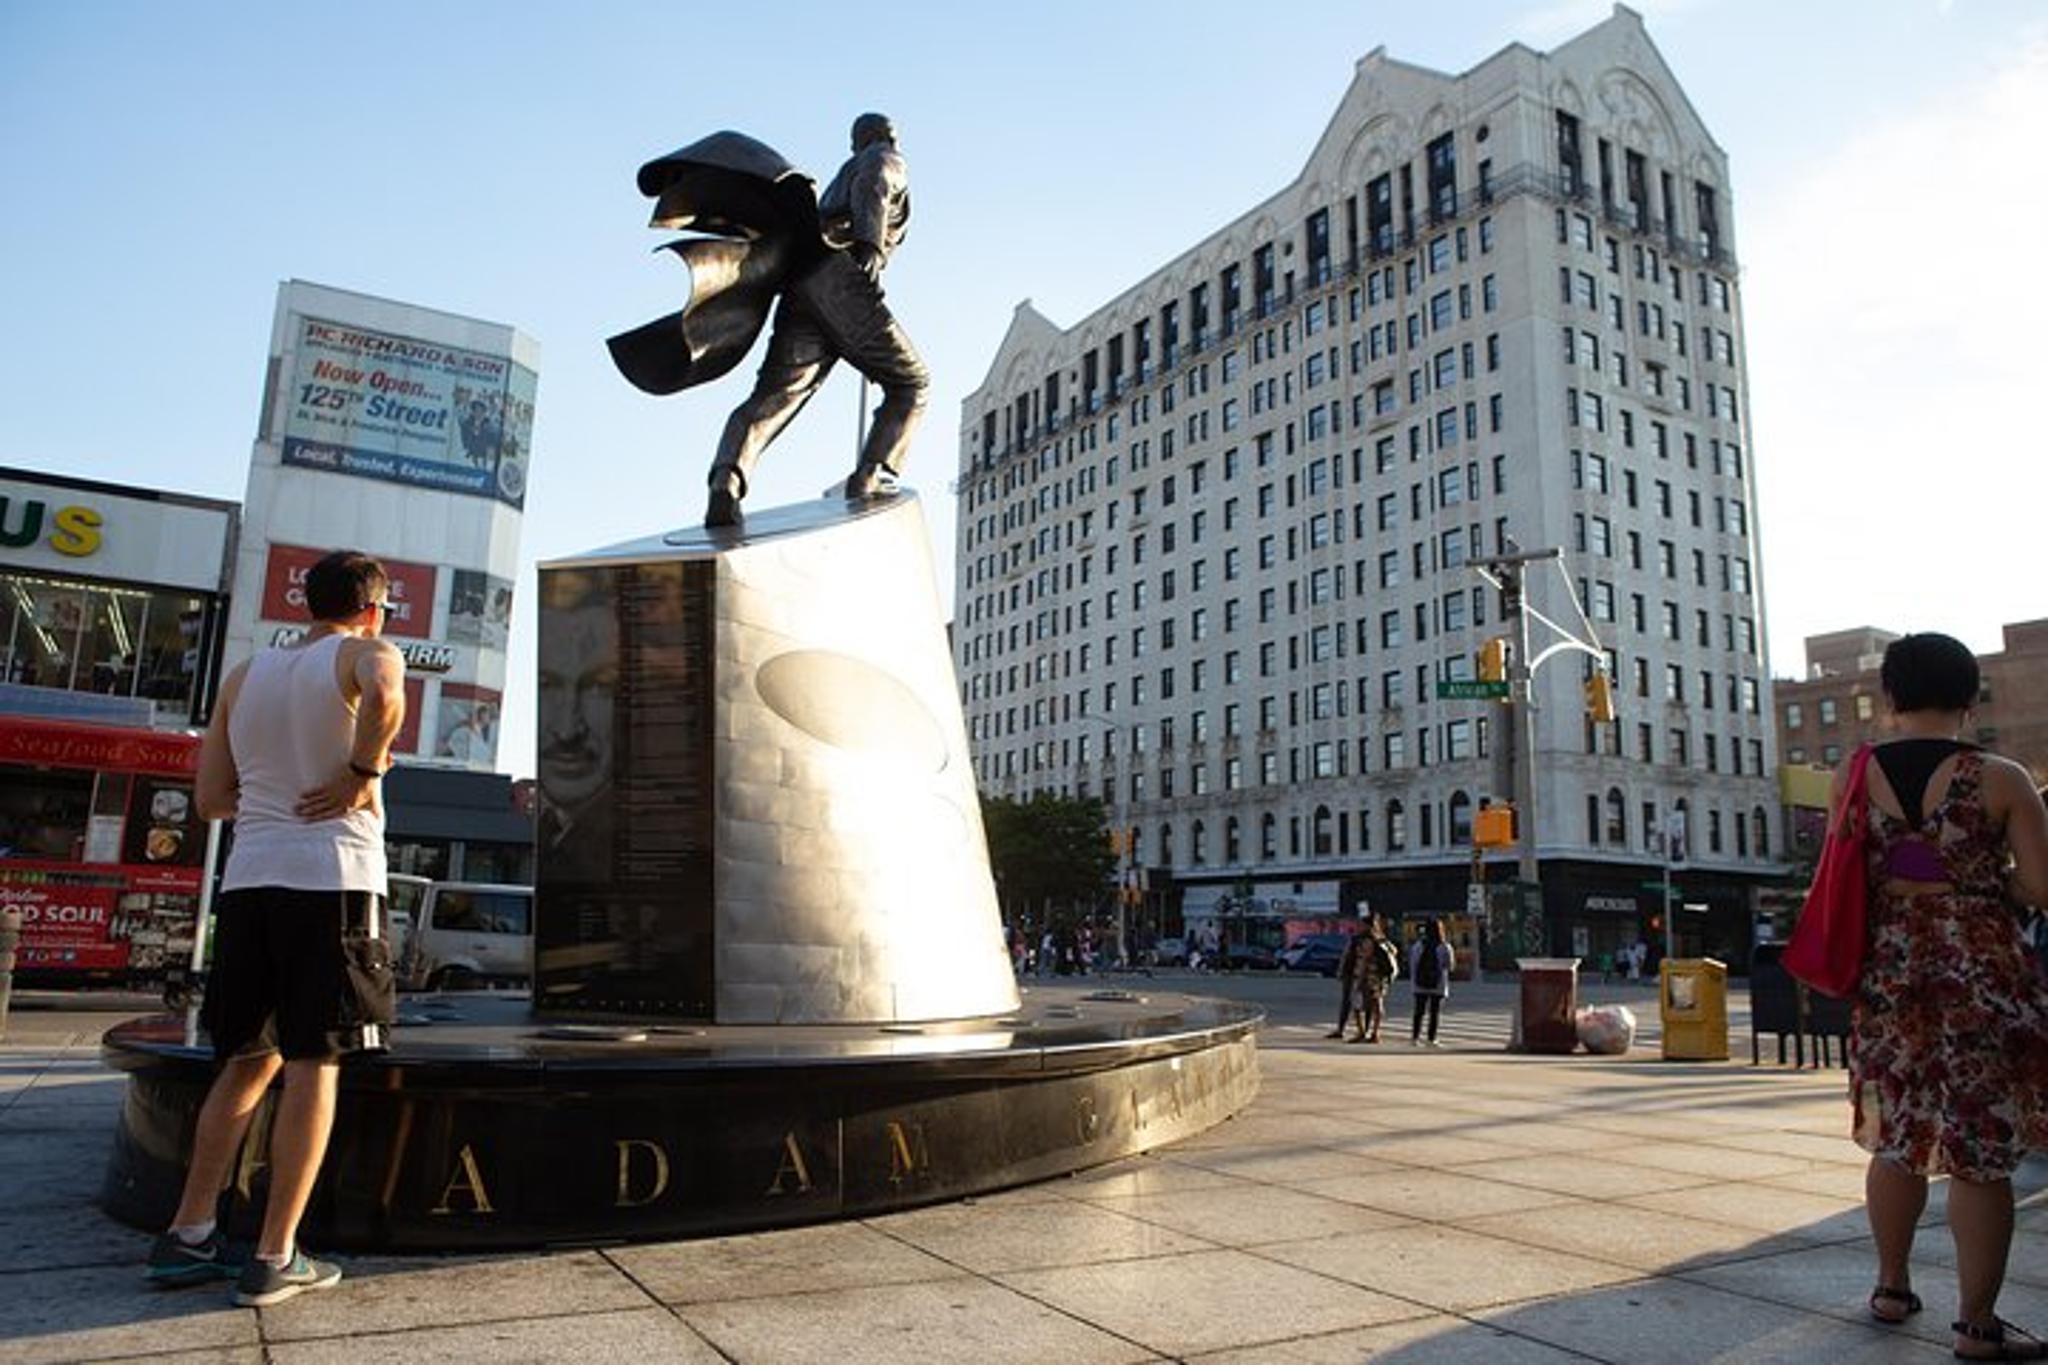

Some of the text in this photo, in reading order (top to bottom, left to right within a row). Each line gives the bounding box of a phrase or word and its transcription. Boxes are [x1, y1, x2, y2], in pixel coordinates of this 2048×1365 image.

[312, 358, 365, 385] Now
[366, 394, 448, 429] Street
[45, 904, 105, 923] SOUL
